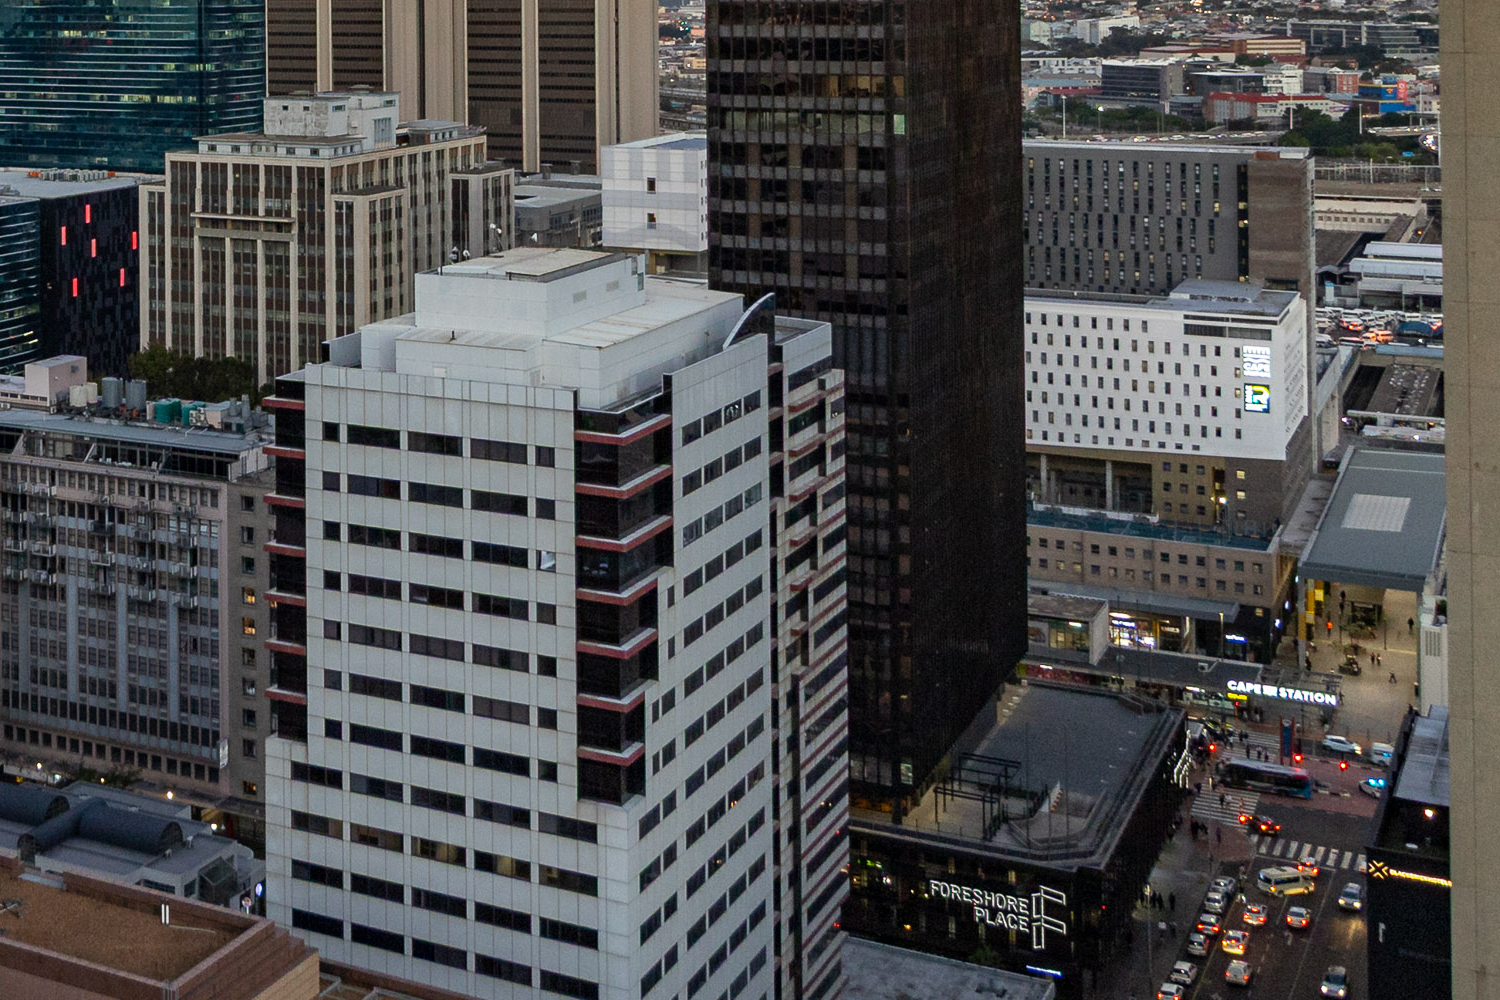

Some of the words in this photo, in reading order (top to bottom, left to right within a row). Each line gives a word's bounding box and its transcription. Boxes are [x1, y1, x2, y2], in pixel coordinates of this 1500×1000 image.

[1226, 680, 1262, 695] CAPE
[1278, 686, 1338, 706] STATION
[929, 879, 1030, 916] FORESHORE
[974, 906, 1030, 933] PLACE
